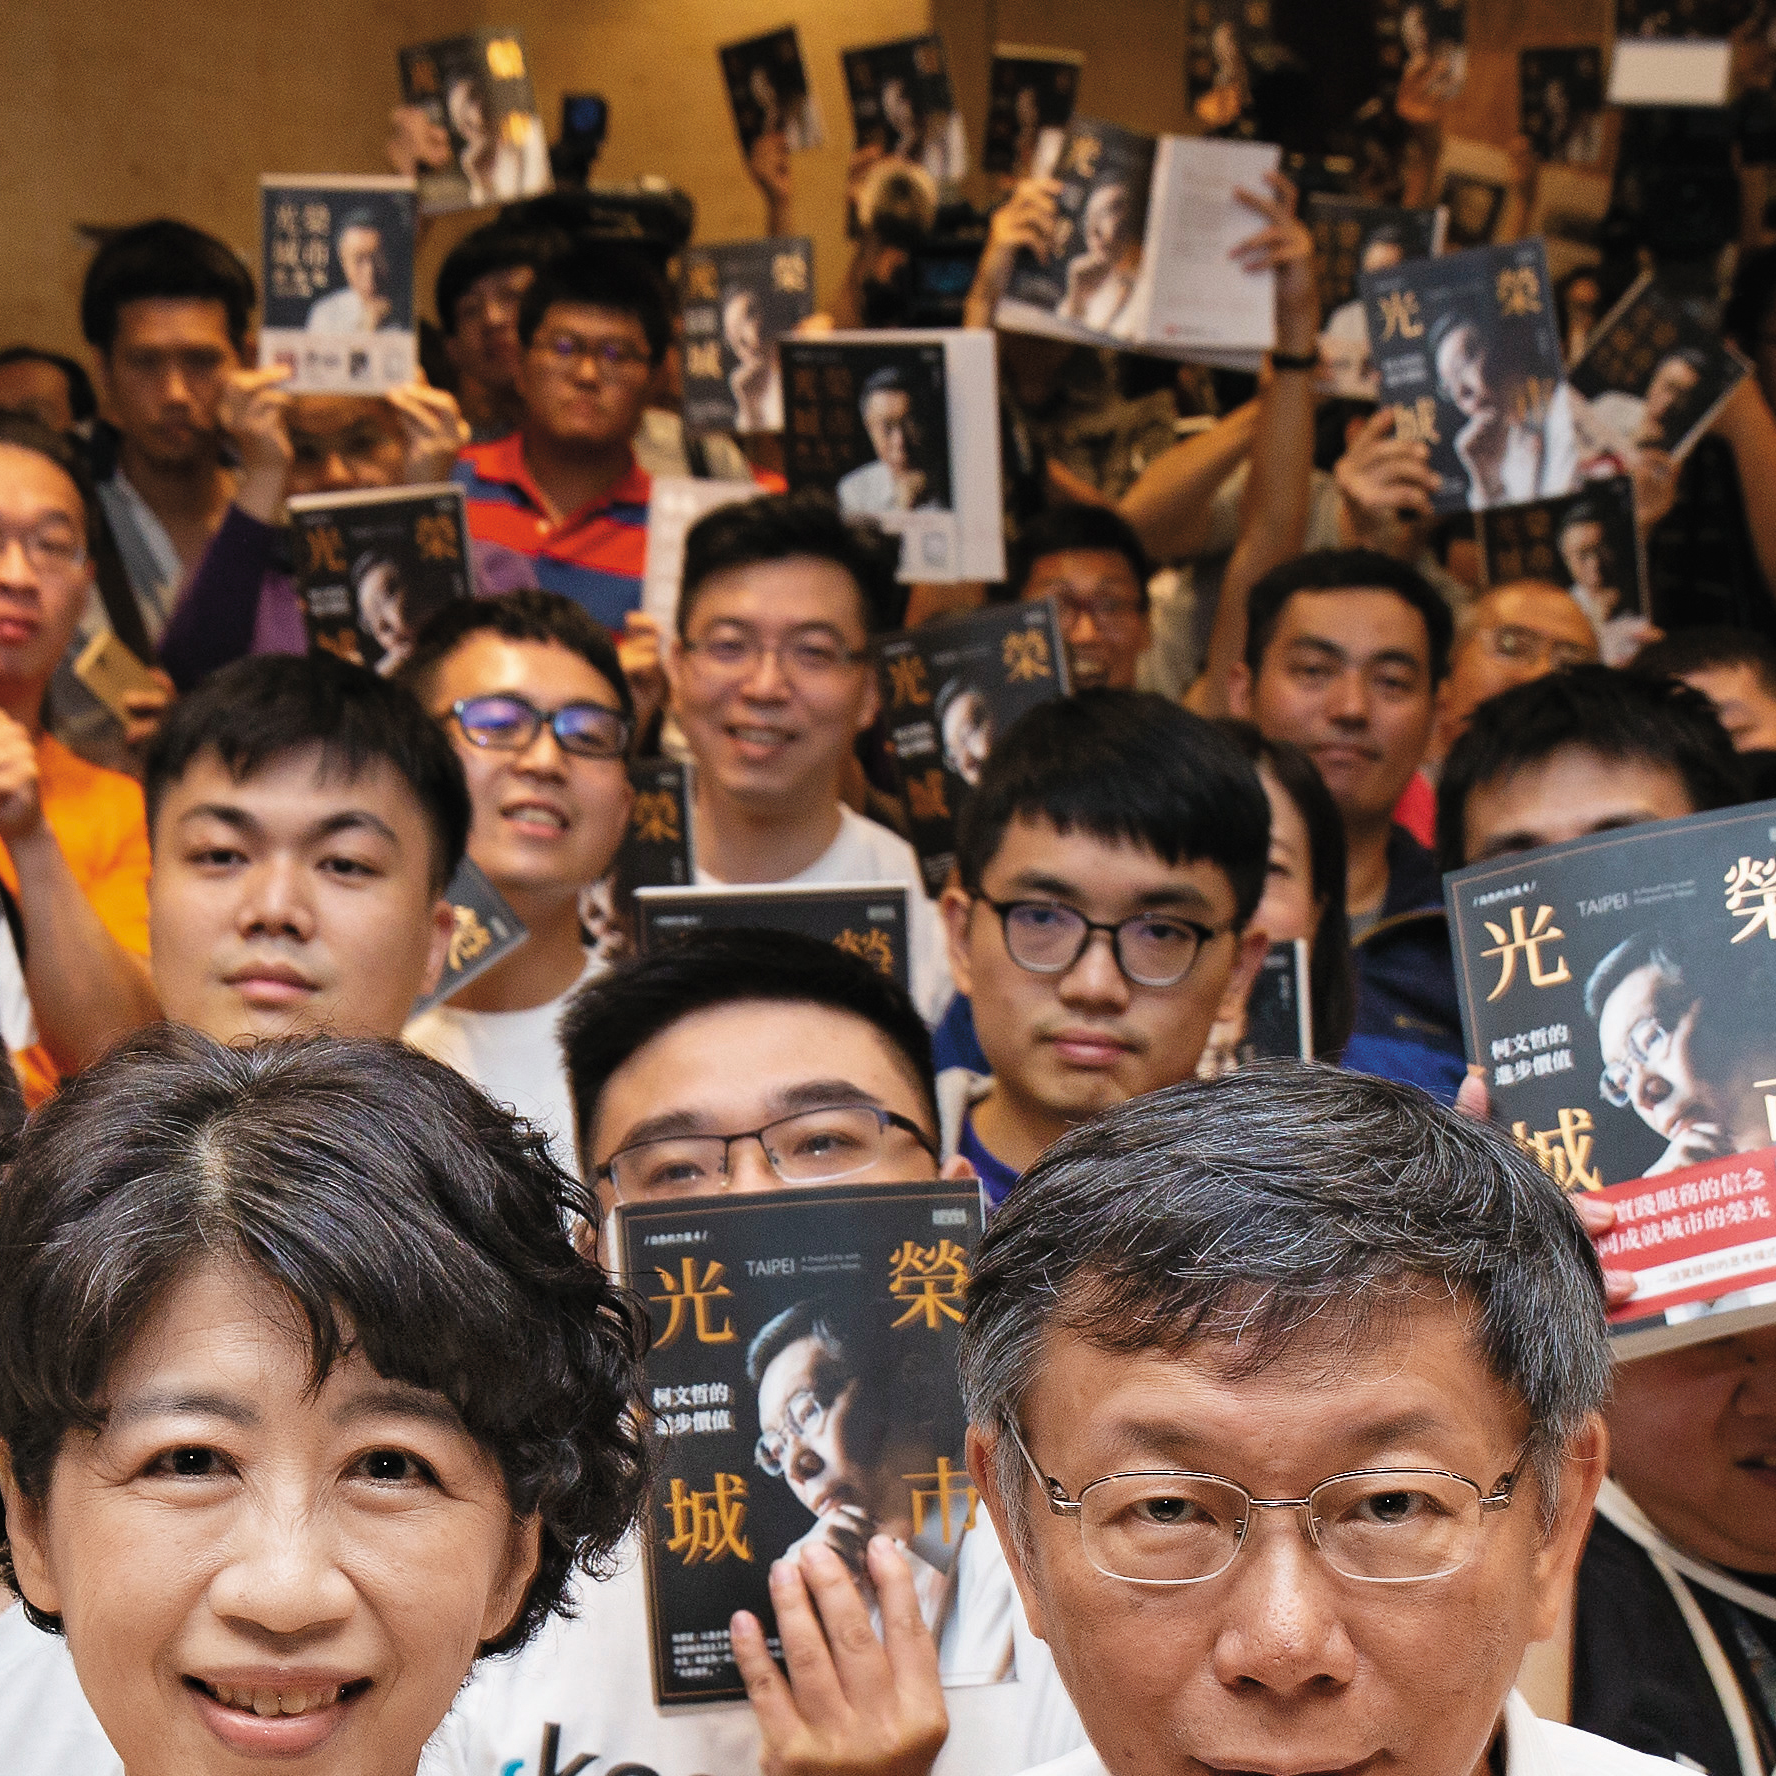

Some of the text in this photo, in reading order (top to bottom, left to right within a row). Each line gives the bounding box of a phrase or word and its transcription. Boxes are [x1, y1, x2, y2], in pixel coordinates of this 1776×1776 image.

[1481, 904, 1572, 1002] 光
[649, 1239, 970, 1349] 光 TAIPEI 榮
[664, 1456, 979, 1566] 城 市
